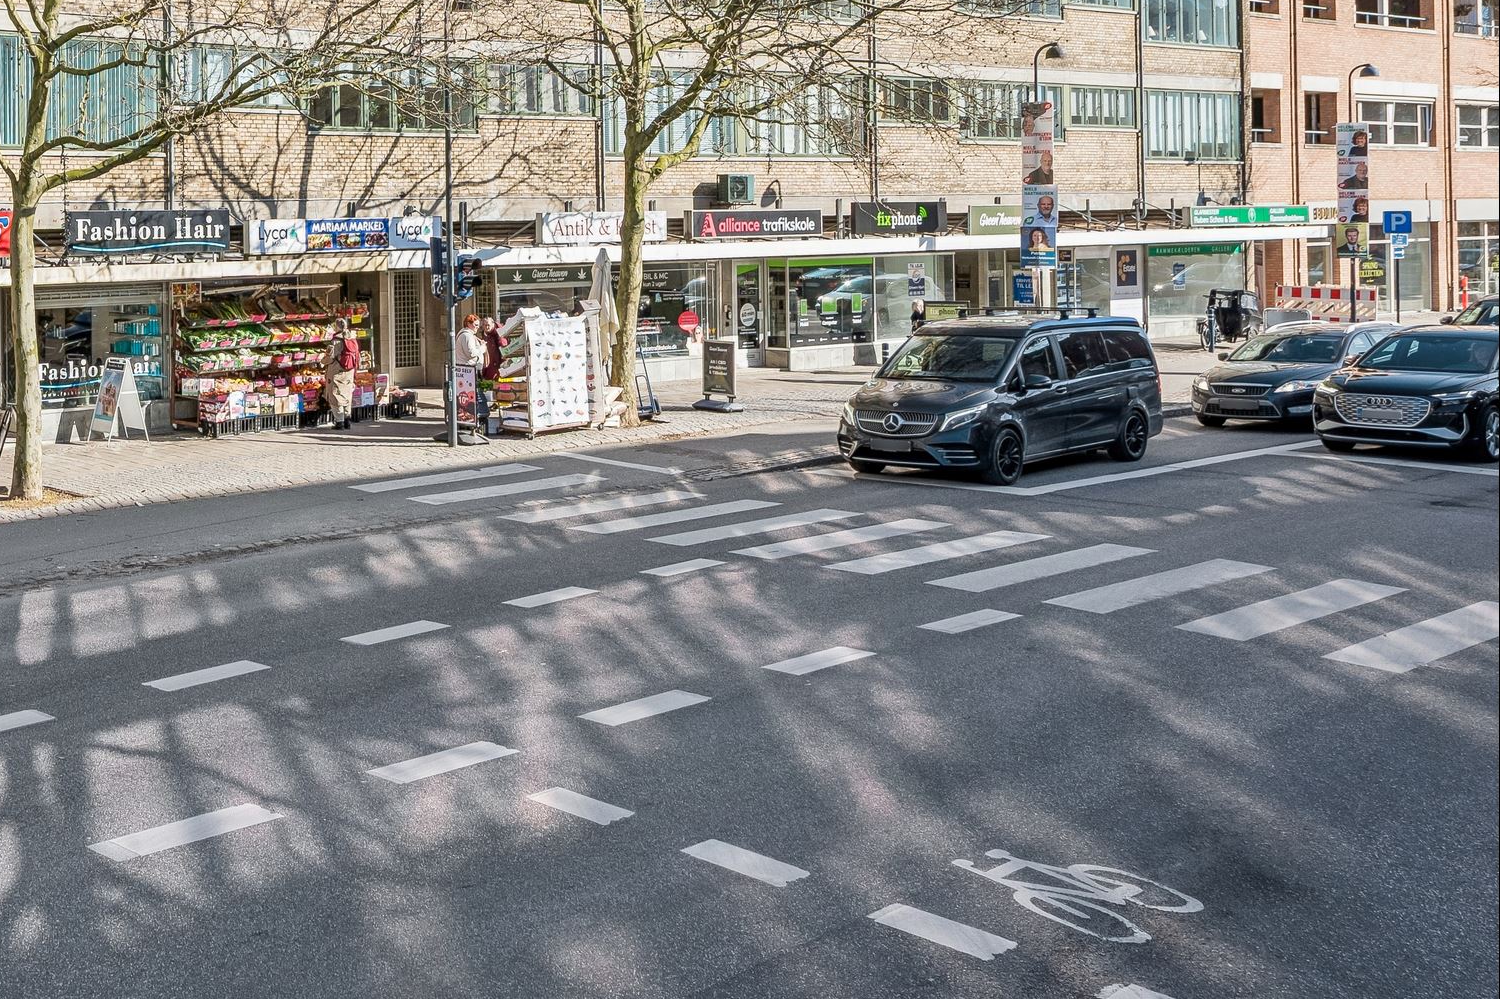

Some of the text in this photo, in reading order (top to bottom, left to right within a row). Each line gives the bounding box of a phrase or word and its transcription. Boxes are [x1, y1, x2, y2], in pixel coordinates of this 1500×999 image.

[75, 215, 225, 242] Fashion Hair
[312, 221, 385, 233] MARIAM MARKED
[553, 219, 593, 237] Antik
[599, 221, 611, 235] &
[719, 217, 760, 233] alliance
[762, 216, 816, 232] trafikskole
[877, 211, 923, 230] fixphone
[1391, 214, 1407, 231] P
[258, 227, 288, 242] Lyca
[395, 223, 422, 240] Lyca
